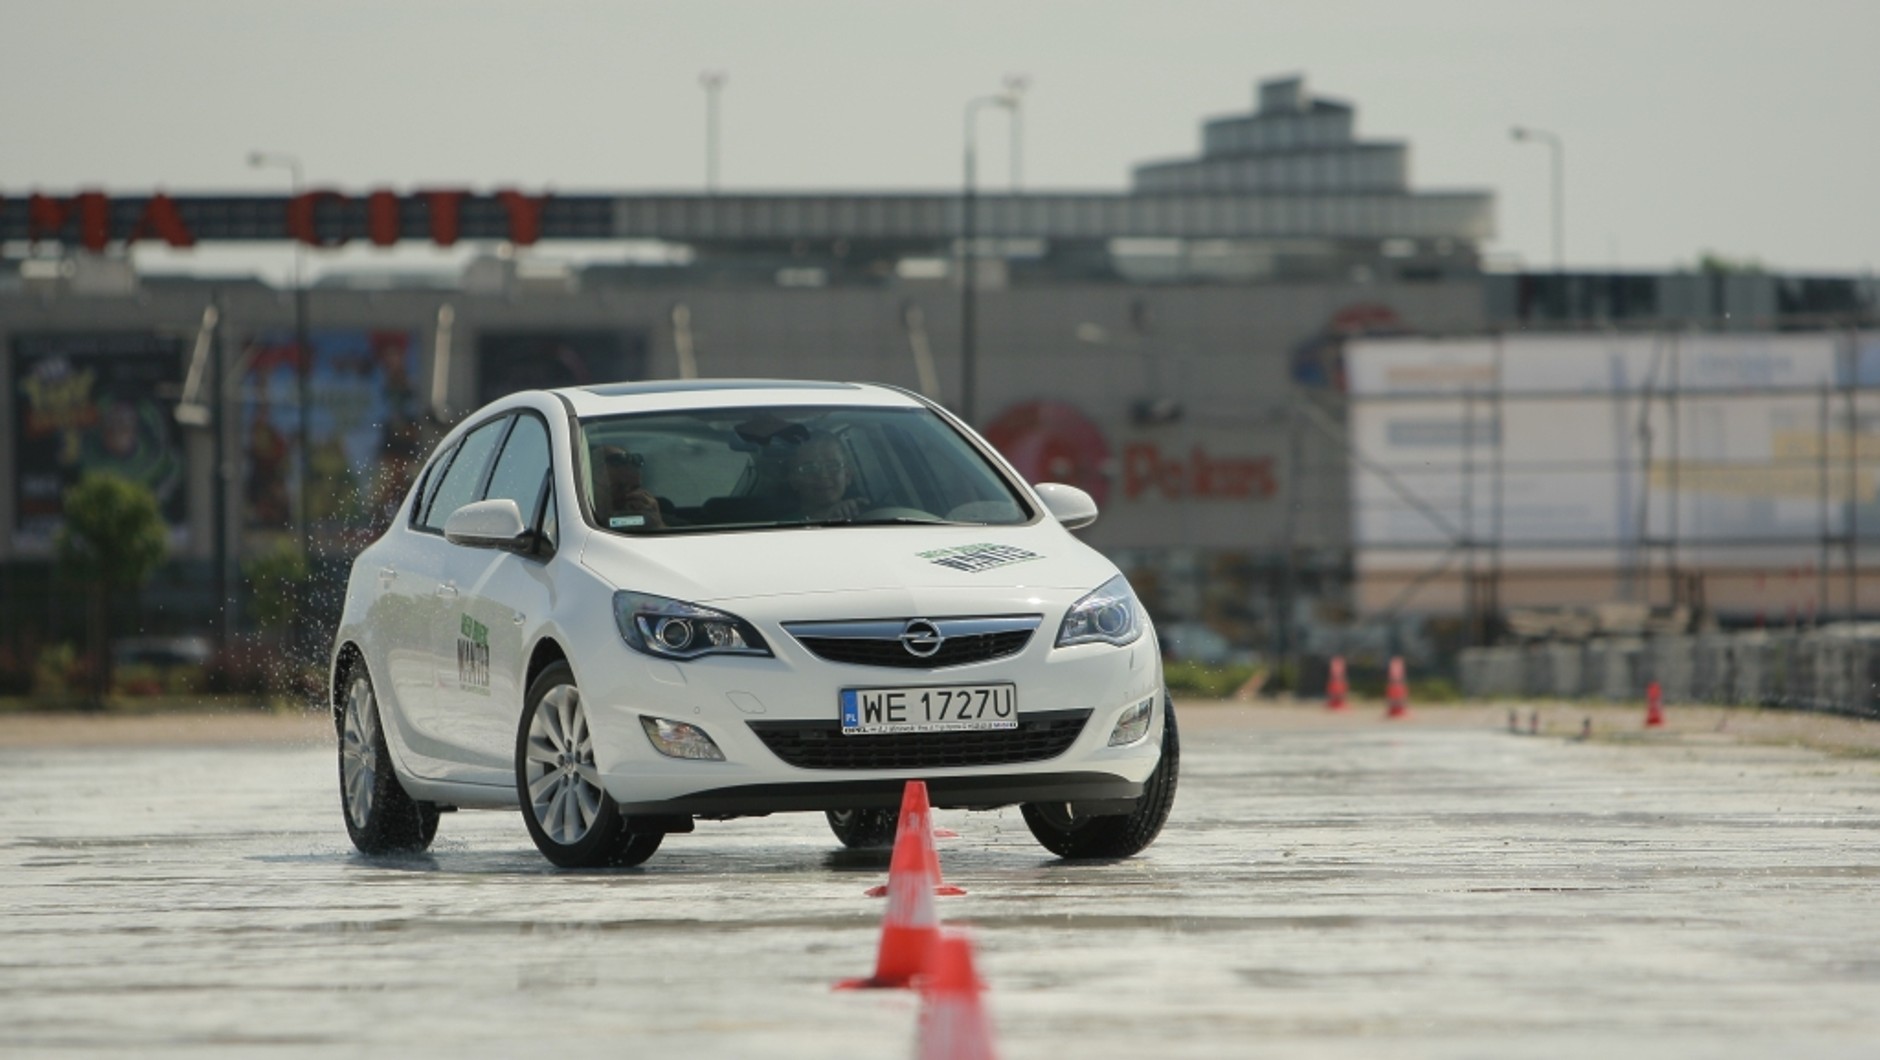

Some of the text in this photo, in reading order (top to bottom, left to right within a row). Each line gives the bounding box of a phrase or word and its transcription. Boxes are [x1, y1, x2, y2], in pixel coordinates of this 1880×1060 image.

[287, 188, 556, 248] CITY
[845, 713, 857, 723] PL
[863, 689, 1011, 724] WE 1727U
